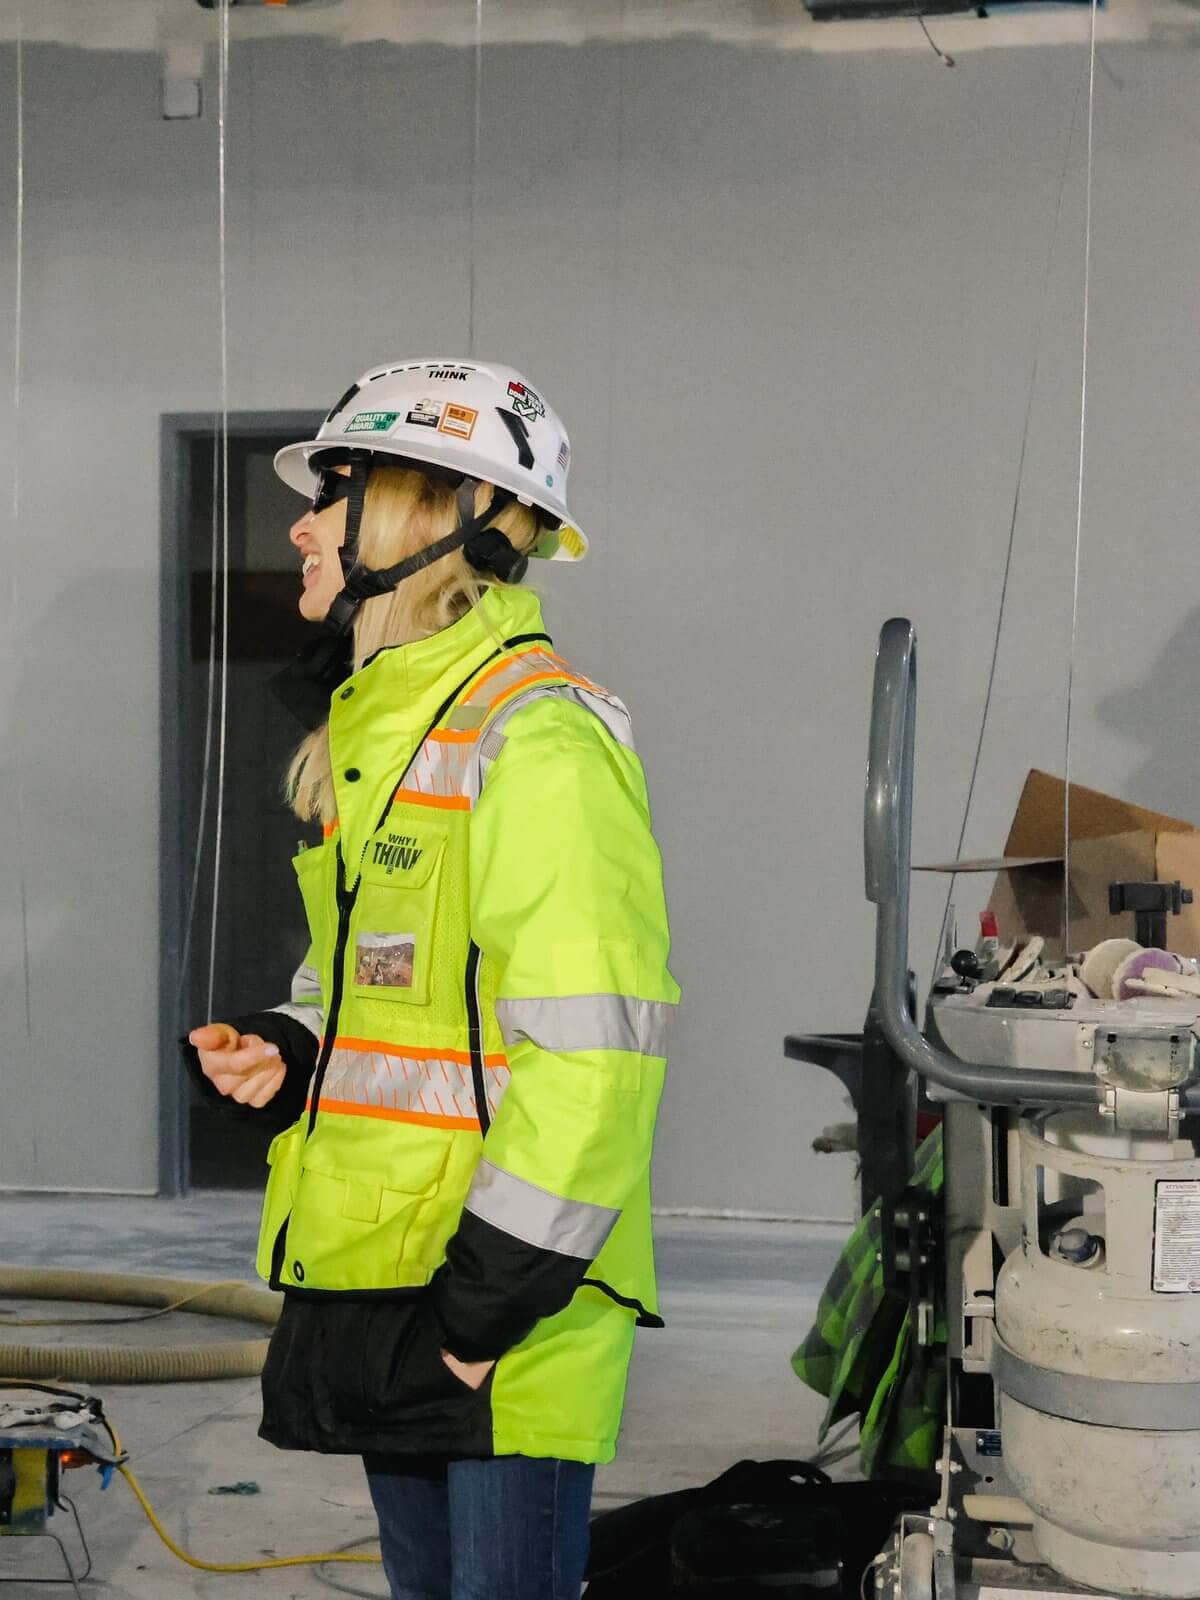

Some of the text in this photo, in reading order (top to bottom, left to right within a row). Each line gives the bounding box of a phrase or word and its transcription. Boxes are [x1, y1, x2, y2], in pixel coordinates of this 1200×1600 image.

[428, 370, 469, 381] THINK
[354, 414, 385, 423] QUALITY
[388, 833, 411, 846] WHY
[372, 841, 423, 871] THINK
